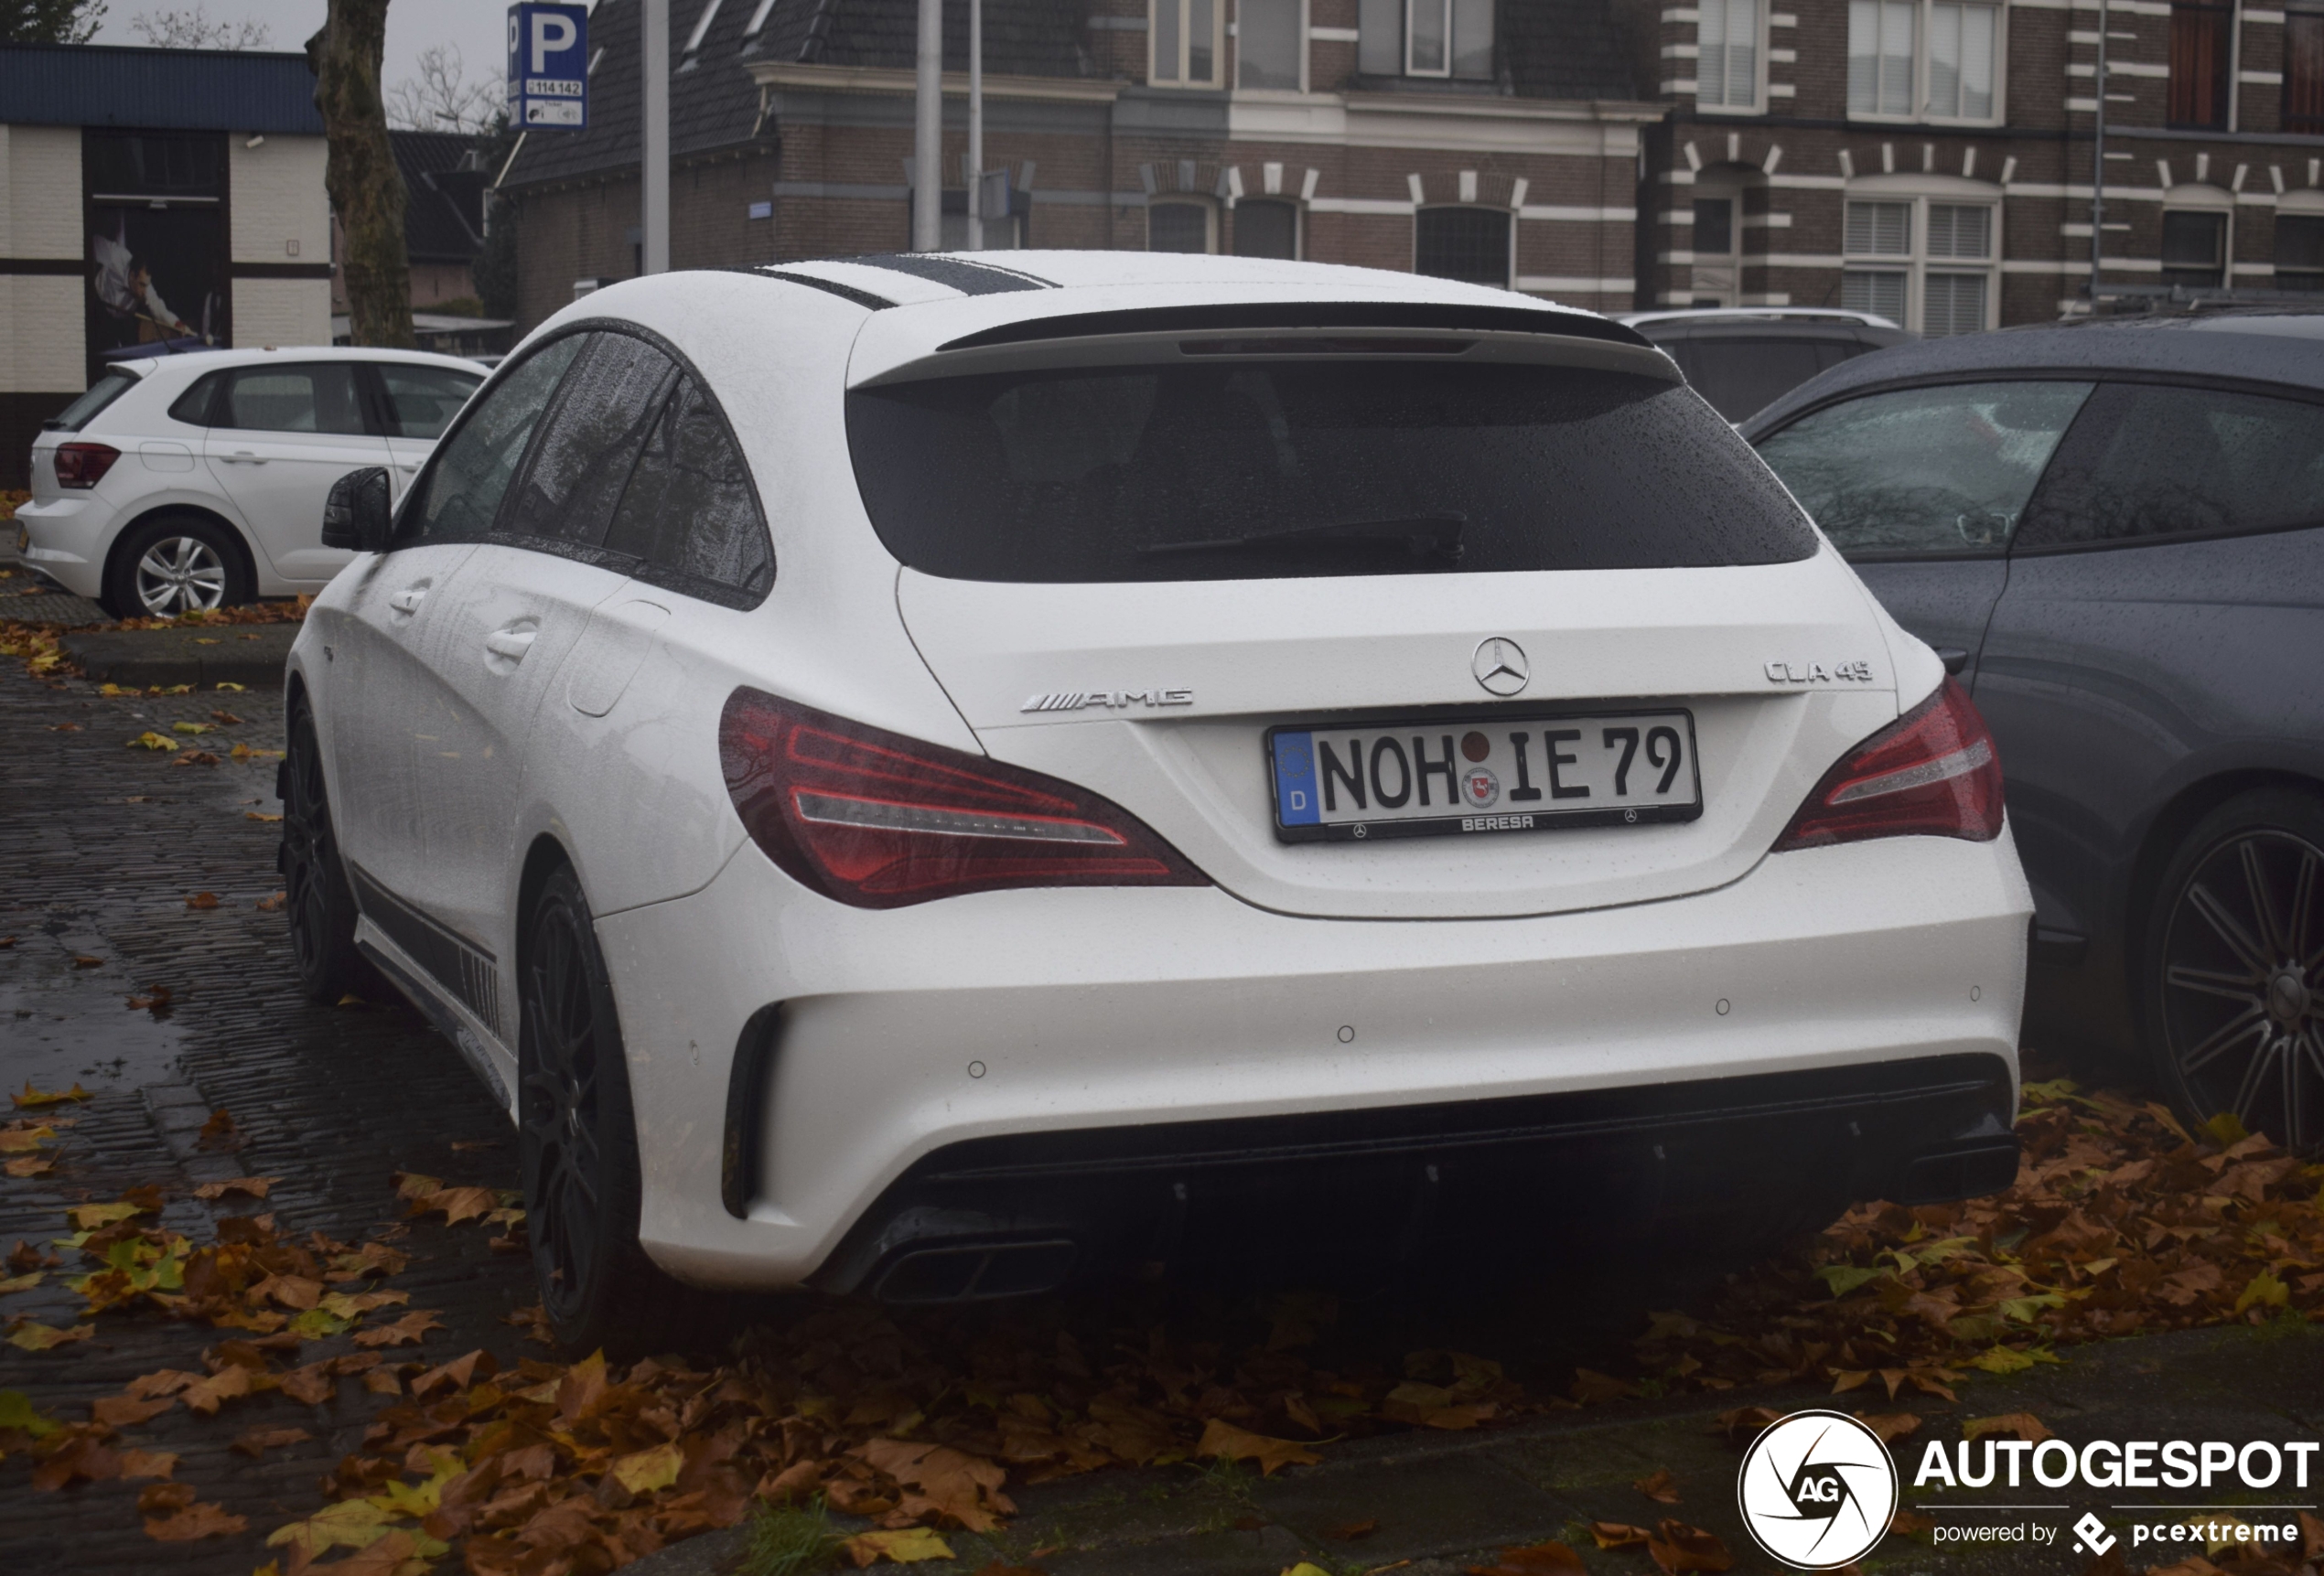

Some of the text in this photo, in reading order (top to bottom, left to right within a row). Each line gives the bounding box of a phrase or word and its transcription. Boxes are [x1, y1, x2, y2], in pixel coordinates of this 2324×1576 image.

[532, 13, 576, 73] P
[536, 82, 580, 95] 114 142
[1764, 660, 1873, 681] CLA 45
[1072, 687, 1193, 708] AMG
[1318, 735, 1460, 812] NOH
[1509, 729, 1591, 801] IE
[1603, 725, 1682, 797] 79
[1291, 791, 1307, 810] D
[1461, 815, 1534, 831] BERESA
